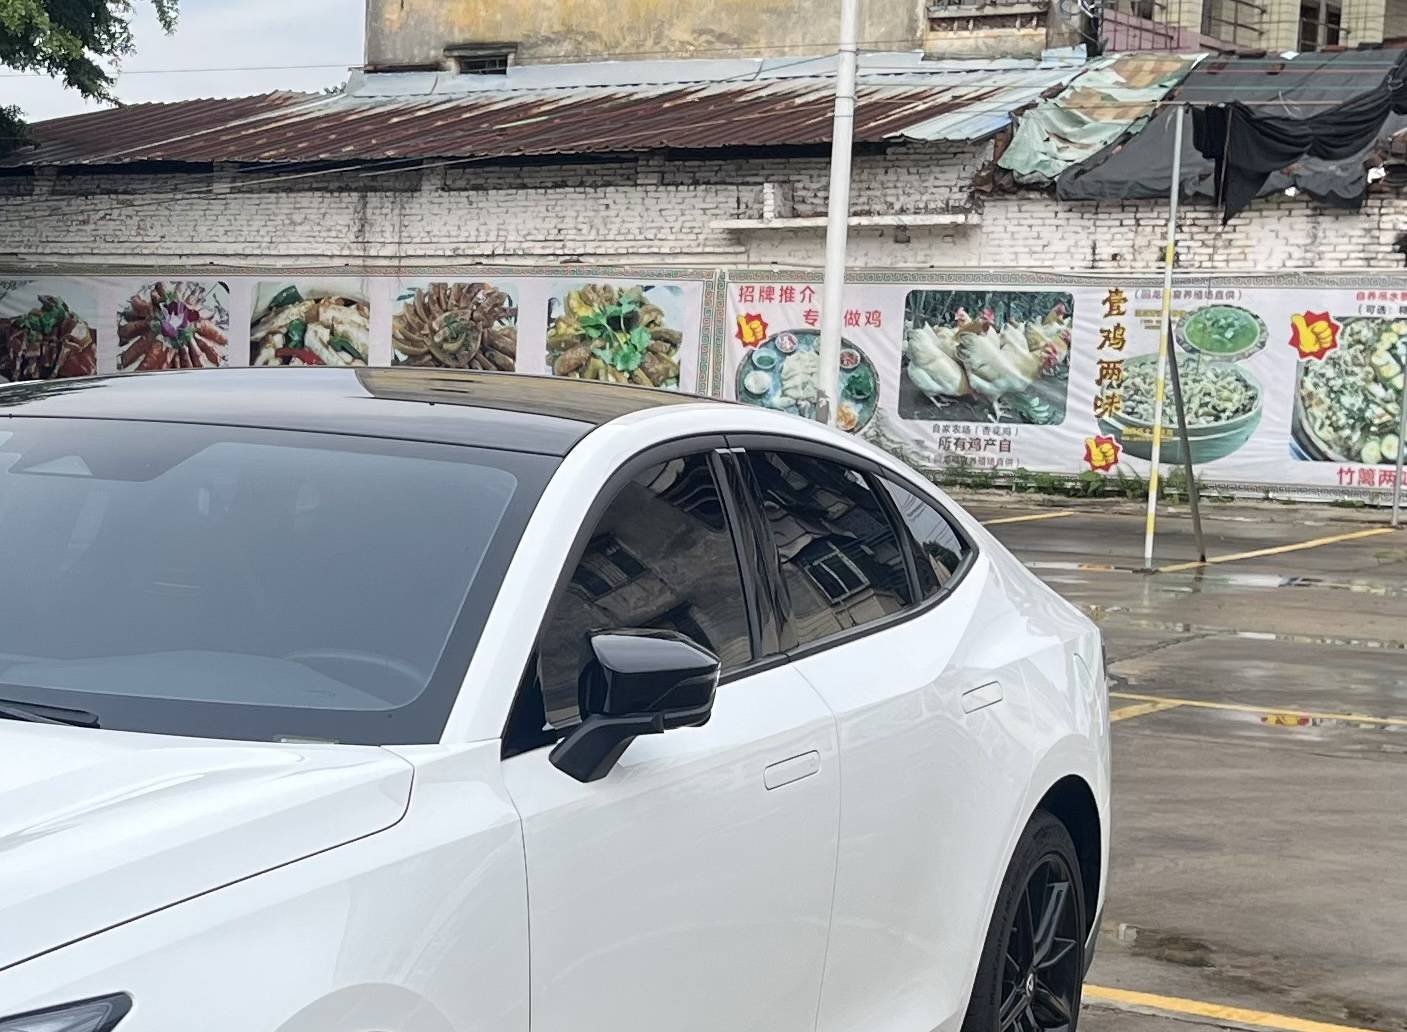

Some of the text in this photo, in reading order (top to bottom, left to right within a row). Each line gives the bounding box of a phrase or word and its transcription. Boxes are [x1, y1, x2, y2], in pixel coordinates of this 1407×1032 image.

[738, 285, 815, 303] 招牌推介
[803, 309, 882, 328] 专做鸡
[1094, 287, 1128, 418] 壹鸡两味
[938, 437, 1011, 453] 所有鸡产自
